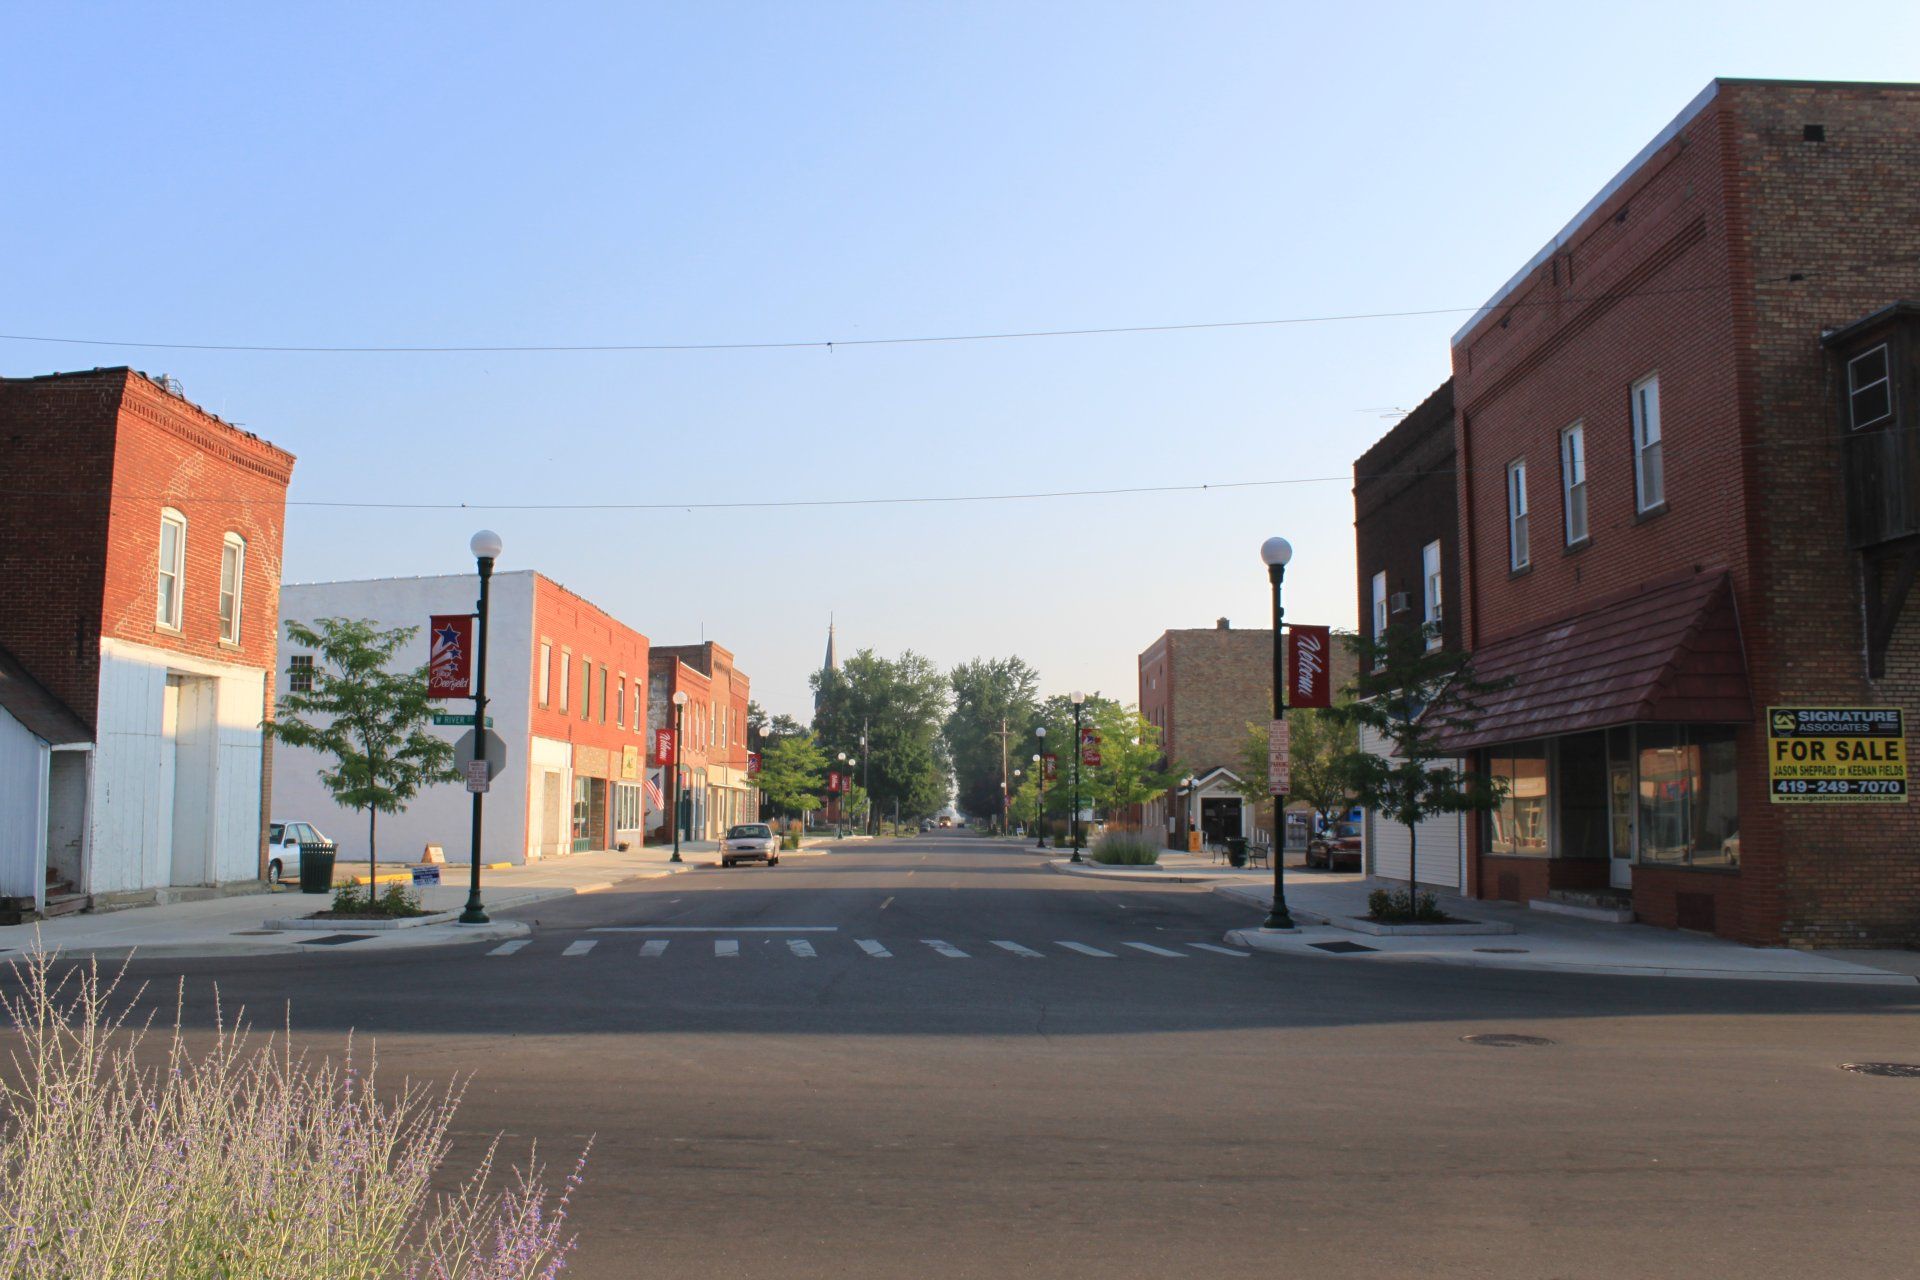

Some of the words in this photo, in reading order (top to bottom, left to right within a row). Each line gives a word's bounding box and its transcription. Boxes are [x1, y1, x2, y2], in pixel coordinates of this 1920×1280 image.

[1297, 633, 1323, 698] Welcome
[430, 676, 469, 690] Deerfield
[435, 716, 441, 724] W
[444, 716, 465, 724] RIVER
[1798, 711, 1898, 722] SIGNATURE
[1799, 723, 1870, 732] ASSOCIATES
[1776, 741, 1826, 761] FOR
[1835, 741, 1899, 761] SALE
[1774, 765, 1797, 776] JASON
[1799, 765, 1836, 776] SHEPPARD
[1848, 765, 1877, 776] KEENAN
[1879, 765, 1904, 776] FIELDS
[1777, 781, 1900, 793] 419-249-7070
[1778, 794, 1901, 802] www.signatureassociates.com
